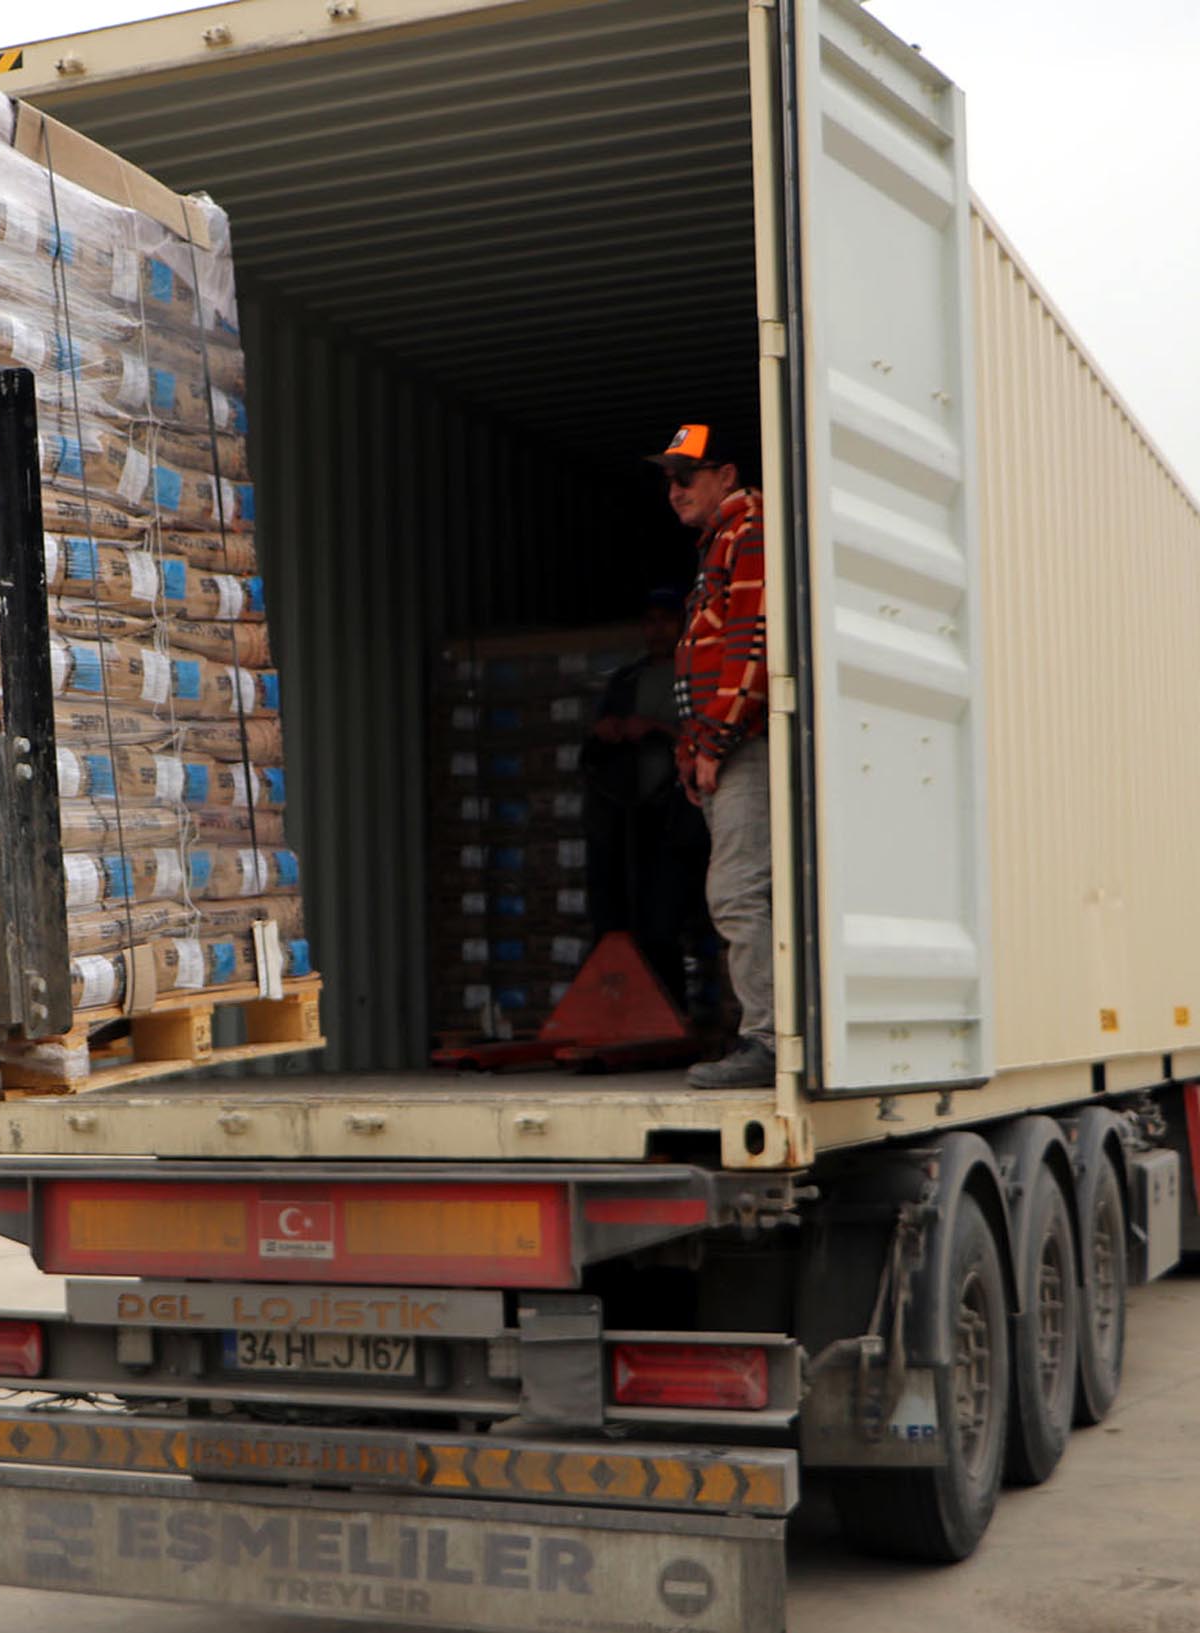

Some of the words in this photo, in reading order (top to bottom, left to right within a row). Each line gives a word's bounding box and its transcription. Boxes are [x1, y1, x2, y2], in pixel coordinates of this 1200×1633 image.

[116, 1292, 206, 1322] DGL
[232, 1291, 442, 1330] LOJİSTİK
[239, 1332, 276, 1367] 34
[285, 1333, 354, 1369] HLJ
[360, 1336, 414, 1373] 167
[263, 1575, 434, 1615] TREYLER
